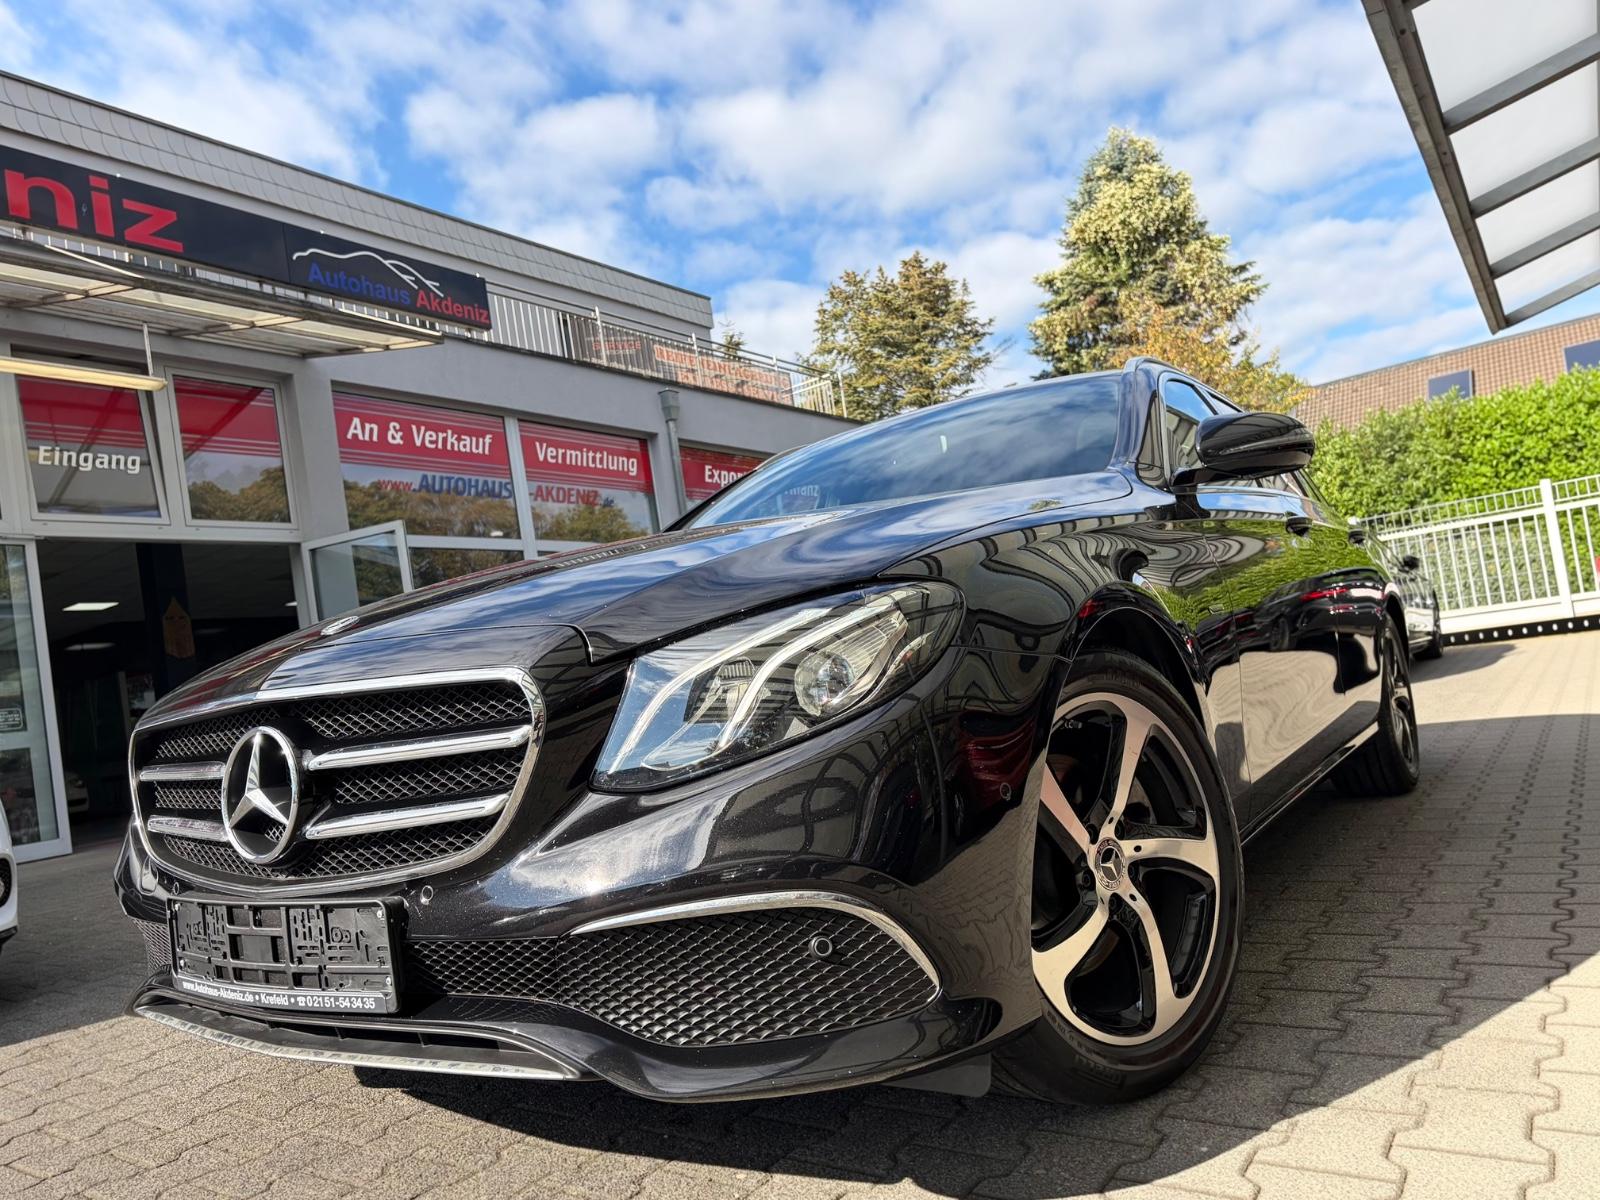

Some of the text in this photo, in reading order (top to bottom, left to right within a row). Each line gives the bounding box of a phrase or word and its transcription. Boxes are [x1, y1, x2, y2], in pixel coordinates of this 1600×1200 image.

[4, 169, 184, 253] niz
[308, 262, 490, 323] Autohaus Akdeniz
[347, 417, 493, 455] An & Verkauf
[38, 445, 141, 474] Eingang
[535, 441, 638, 476] Vermittlung
[260, 992, 289, 1006] Krefeld
